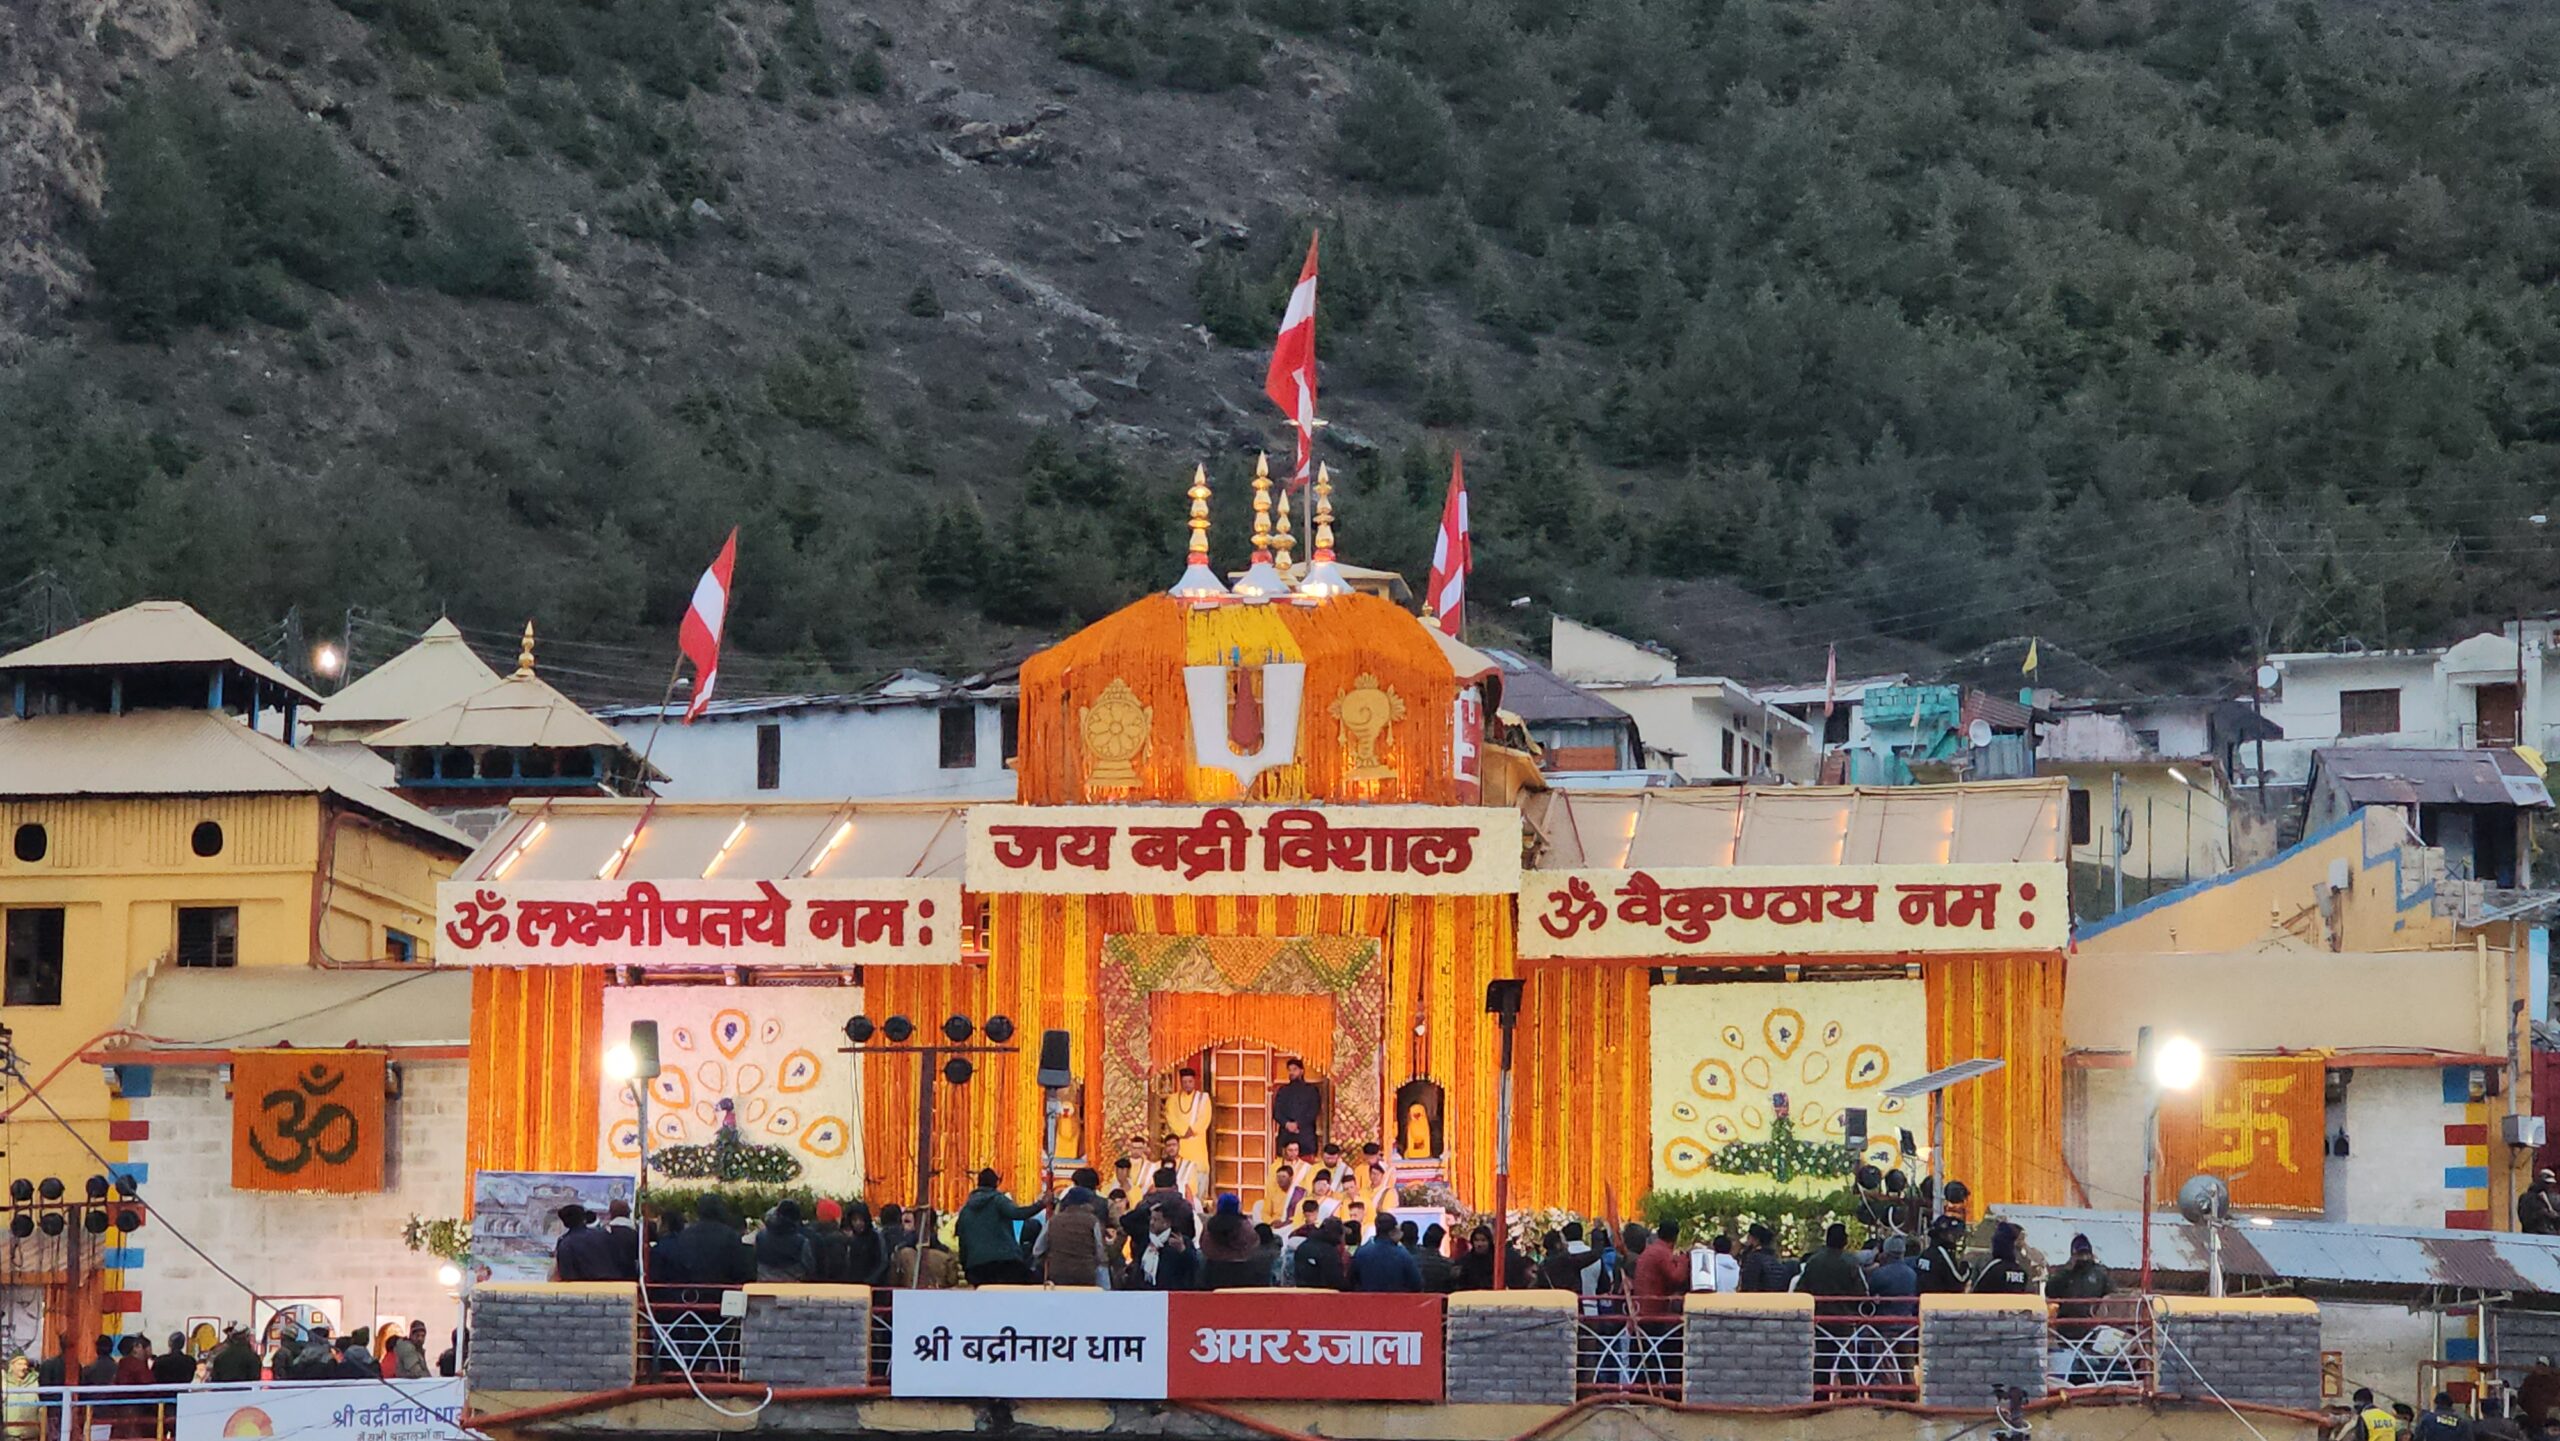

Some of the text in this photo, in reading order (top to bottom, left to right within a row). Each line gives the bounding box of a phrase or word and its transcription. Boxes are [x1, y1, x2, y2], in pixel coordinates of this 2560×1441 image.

[989, 808, 1480, 881] जय बद्री विशाल
[516, 881, 792, 949] लक्ष्मीपतये
[1615, 871, 1878, 944] वैकुण्ठाय
[2005, 1271, 2025, 1284] FIRE
[914, 1326, 1147, 1364] श्री बद्रीनाथ धाम
[1190, 1327, 1423, 1365] अमर उजाला
[332, 1404, 354, 1428] श्री
[357, 1403, 428, 1427] बद्रीनाथ
